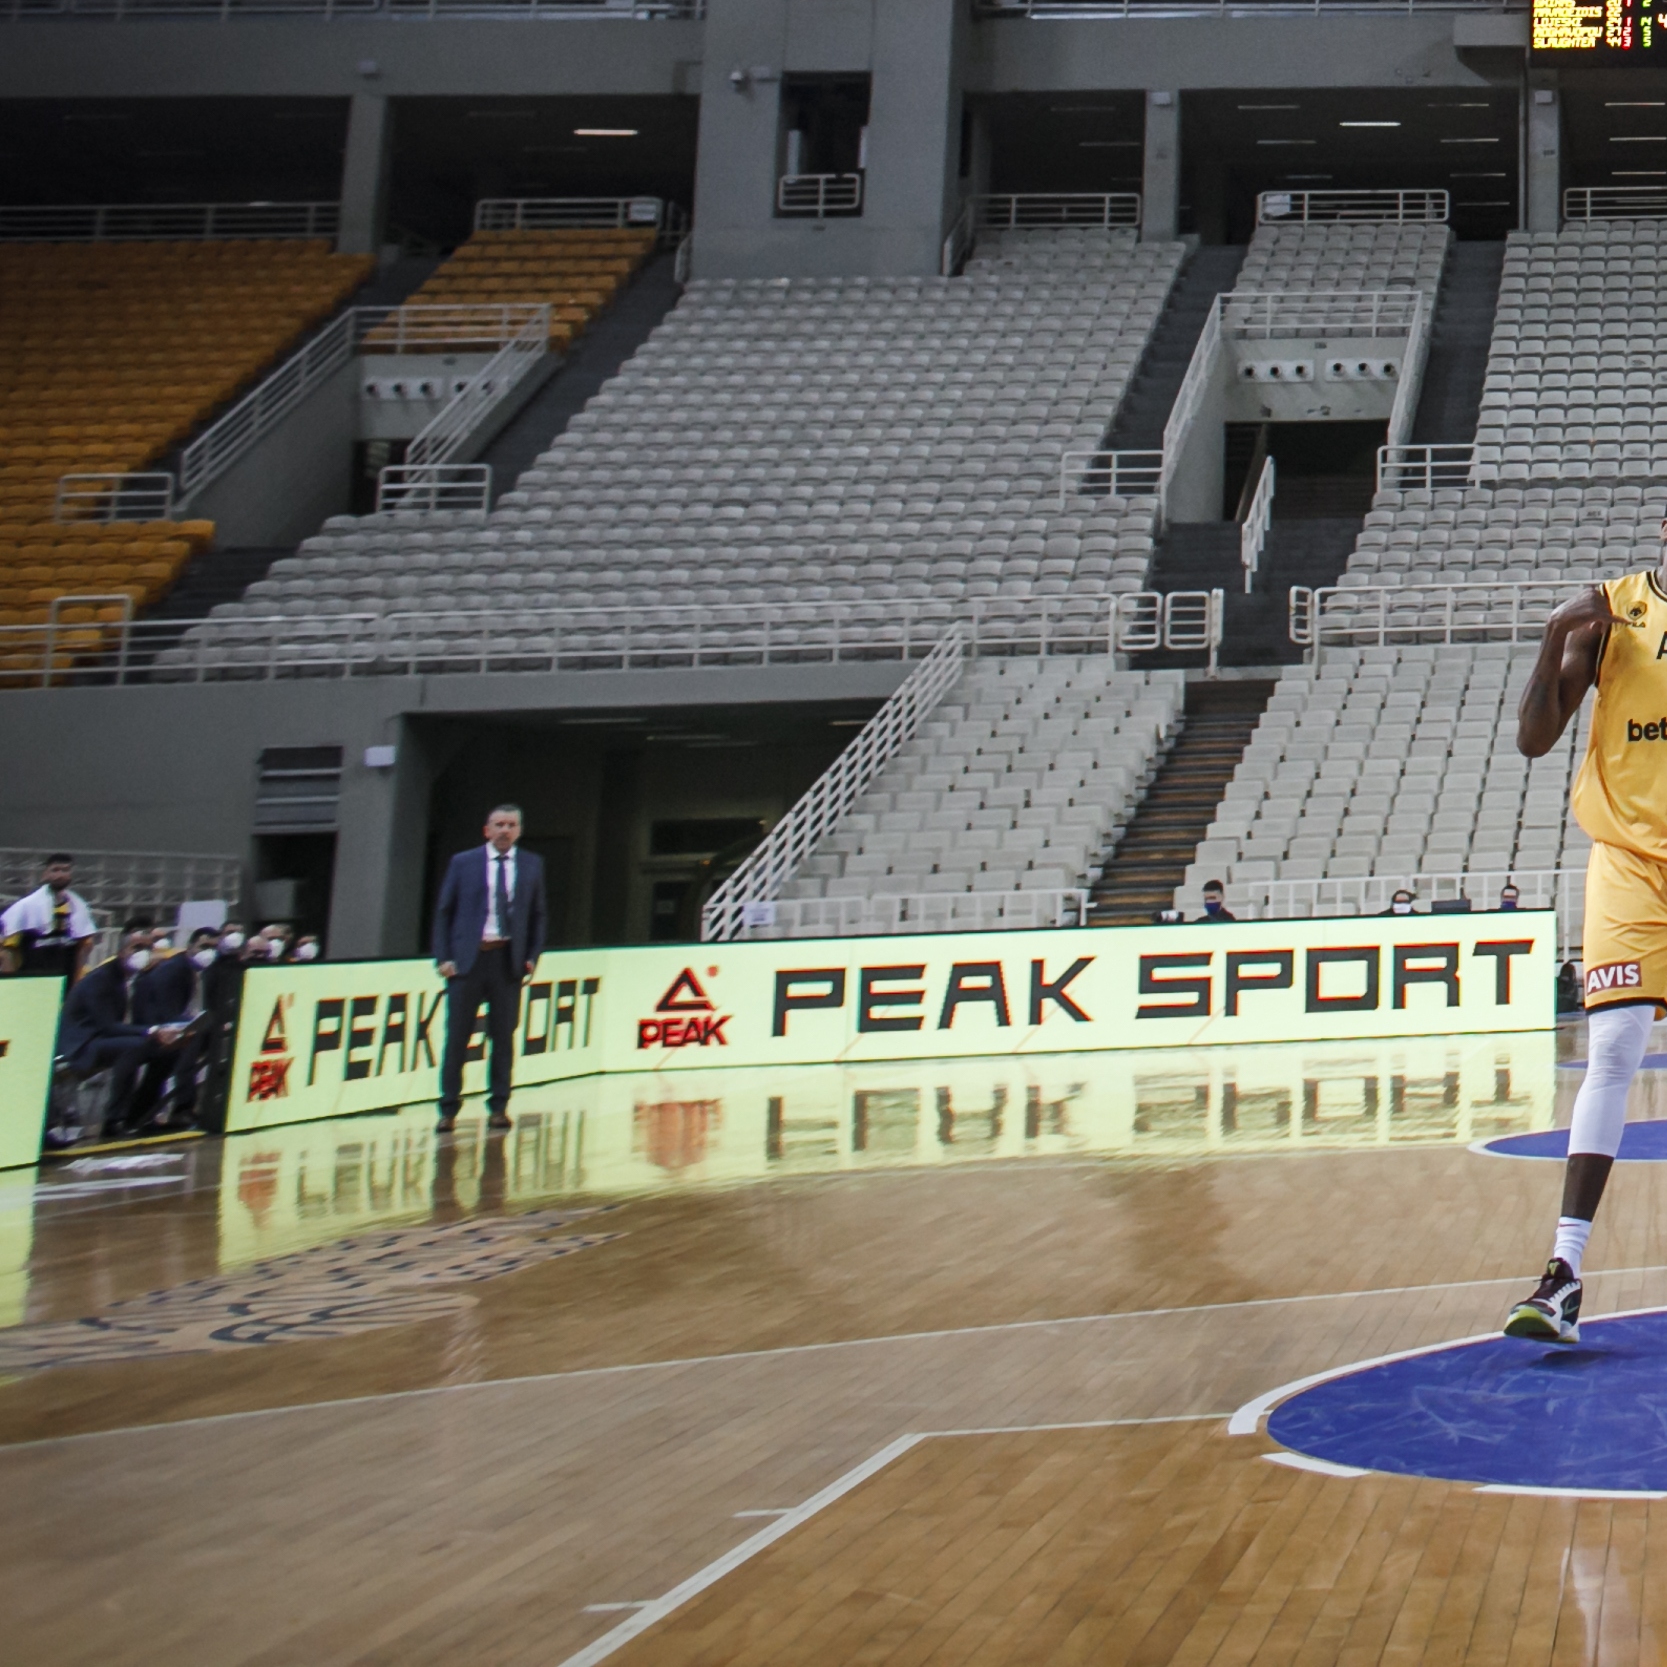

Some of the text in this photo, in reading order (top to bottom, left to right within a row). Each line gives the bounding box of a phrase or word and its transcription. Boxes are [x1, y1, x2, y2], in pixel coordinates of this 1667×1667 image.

[1623, 26, 1632, 36] 2
[1643, 26, 1652, 36] 5
[1626, 17, 1632, 26] 1
[1623, 36, 1632, 48] 3
[771, 938, 1534, 1038] PEAK SPORT
[1588, 964, 1639, 993] AVIS
[307, 989, 447, 1086] PEAK
[637, 1014, 734, 1049] PEAK
